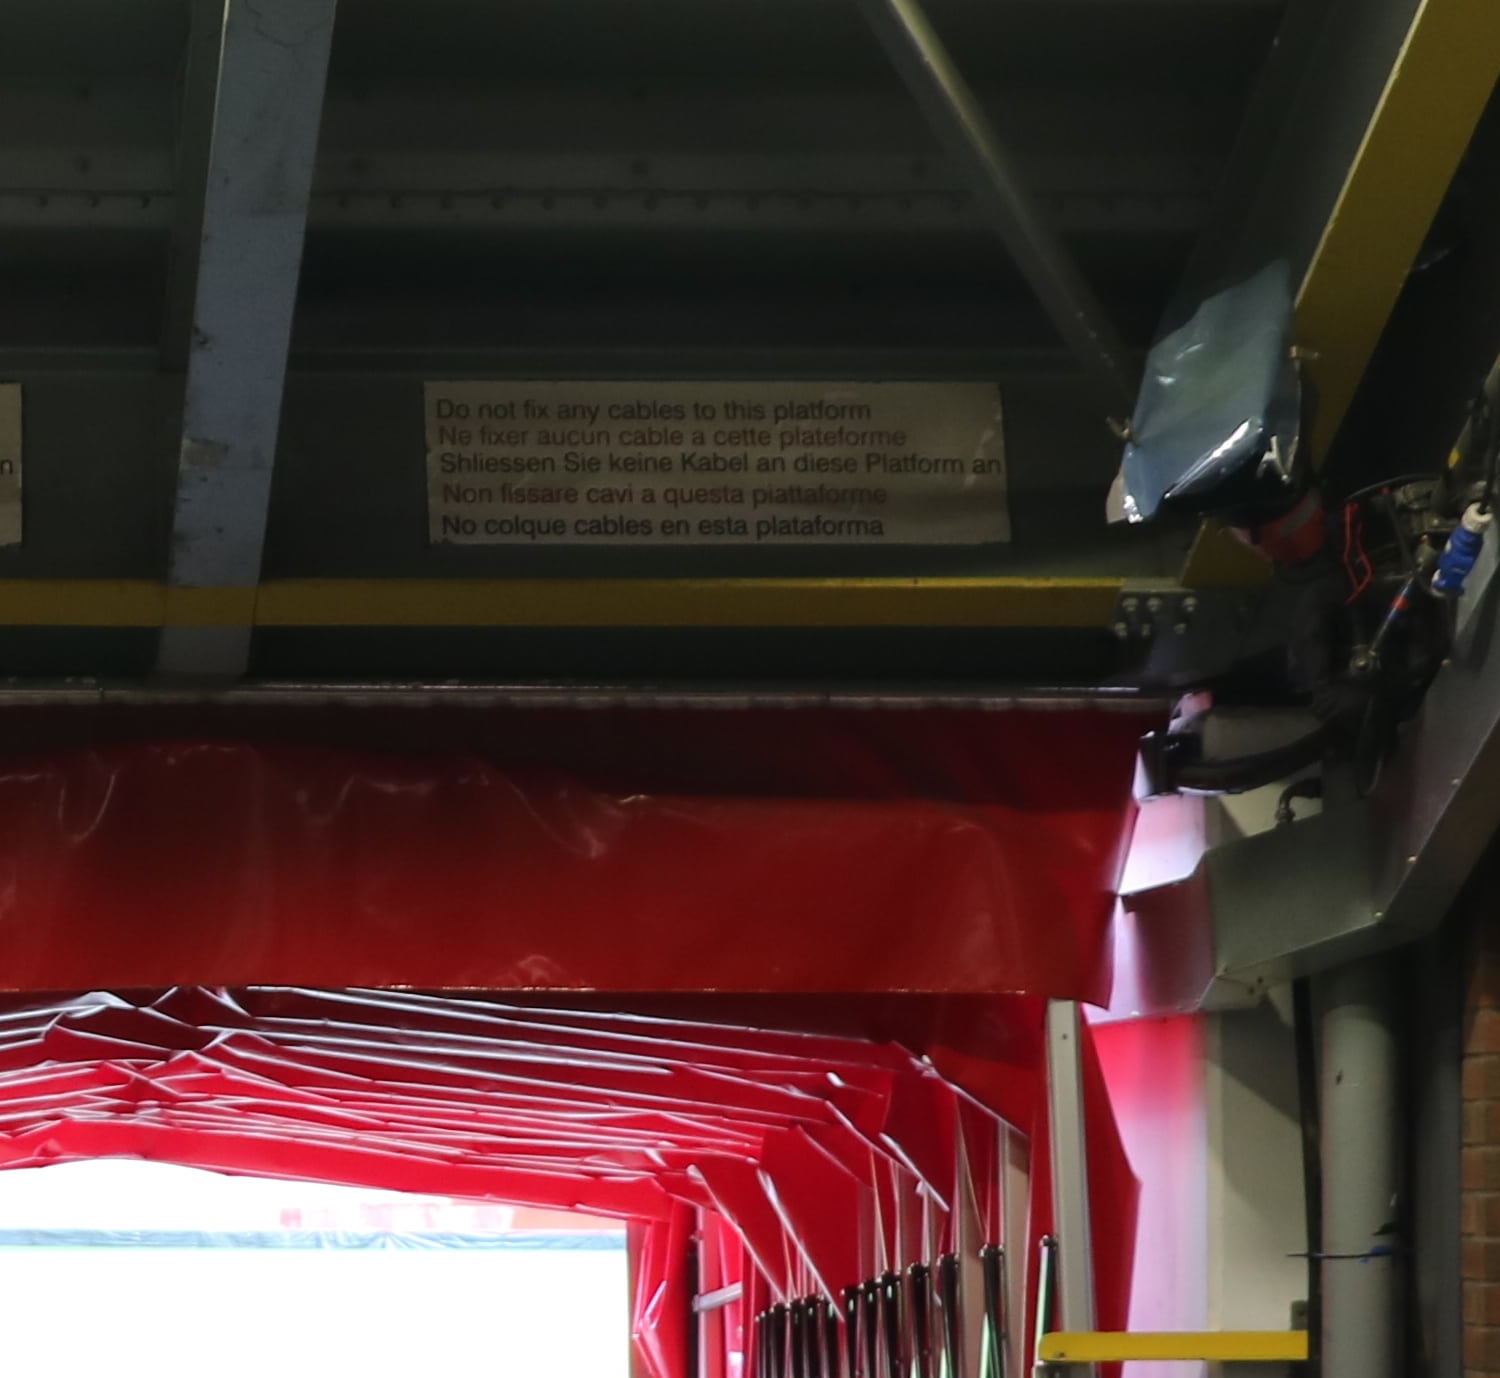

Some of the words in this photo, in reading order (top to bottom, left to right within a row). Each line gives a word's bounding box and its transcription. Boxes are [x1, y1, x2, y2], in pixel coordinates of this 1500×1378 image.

[436, 399, 470, 419] Do
[478, 400, 514, 419] not
[523, 400, 548, 419] fix
[556, 404, 598, 424] any
[608, 400, 684, 419] cables
[692, 400, 717, 419] to
[724, 400, 765, 419] this
[774, 400, 870, 424] platform
[439, 425, 472, 445] Ne
[480, 426, 528, 445] fixer
[537, 430, 610, 445] aucun
[618, 426, 683, 446] cable
[691, 431, 705, 446] a
[714, 426, 771, 446] cette
[780, 426, 906, 451] plateforme
[440, 452, 555, 472] Shliessen
[564, 452, 601, 472] Sie
[609, 452, 672, 472] keine
[682, 453, 748, 472] Kabel
[756, 457, 785, 472] an
[794, 453, 856, 473] diese
[866, 453, 964, 473] Platform
[972, 458, 1000, 473] an
[442, 483, 492, 503] Non
[500, 483, 578, 503] fissare
[586, 483, 633, 503] cavi
[642, 488, 656, 503] a
[664, 484, 744, 508] questa
[752, 484, 886, 509] piattaforme
[442, 514, 476, 534] No
[484, 515, 566, 539] colque
[574, 515, 652, 535] cables
[661, 520, 690, 535] en
[698, 515, 747, 535] esta
[756, 516, 884, 540] plataforma
